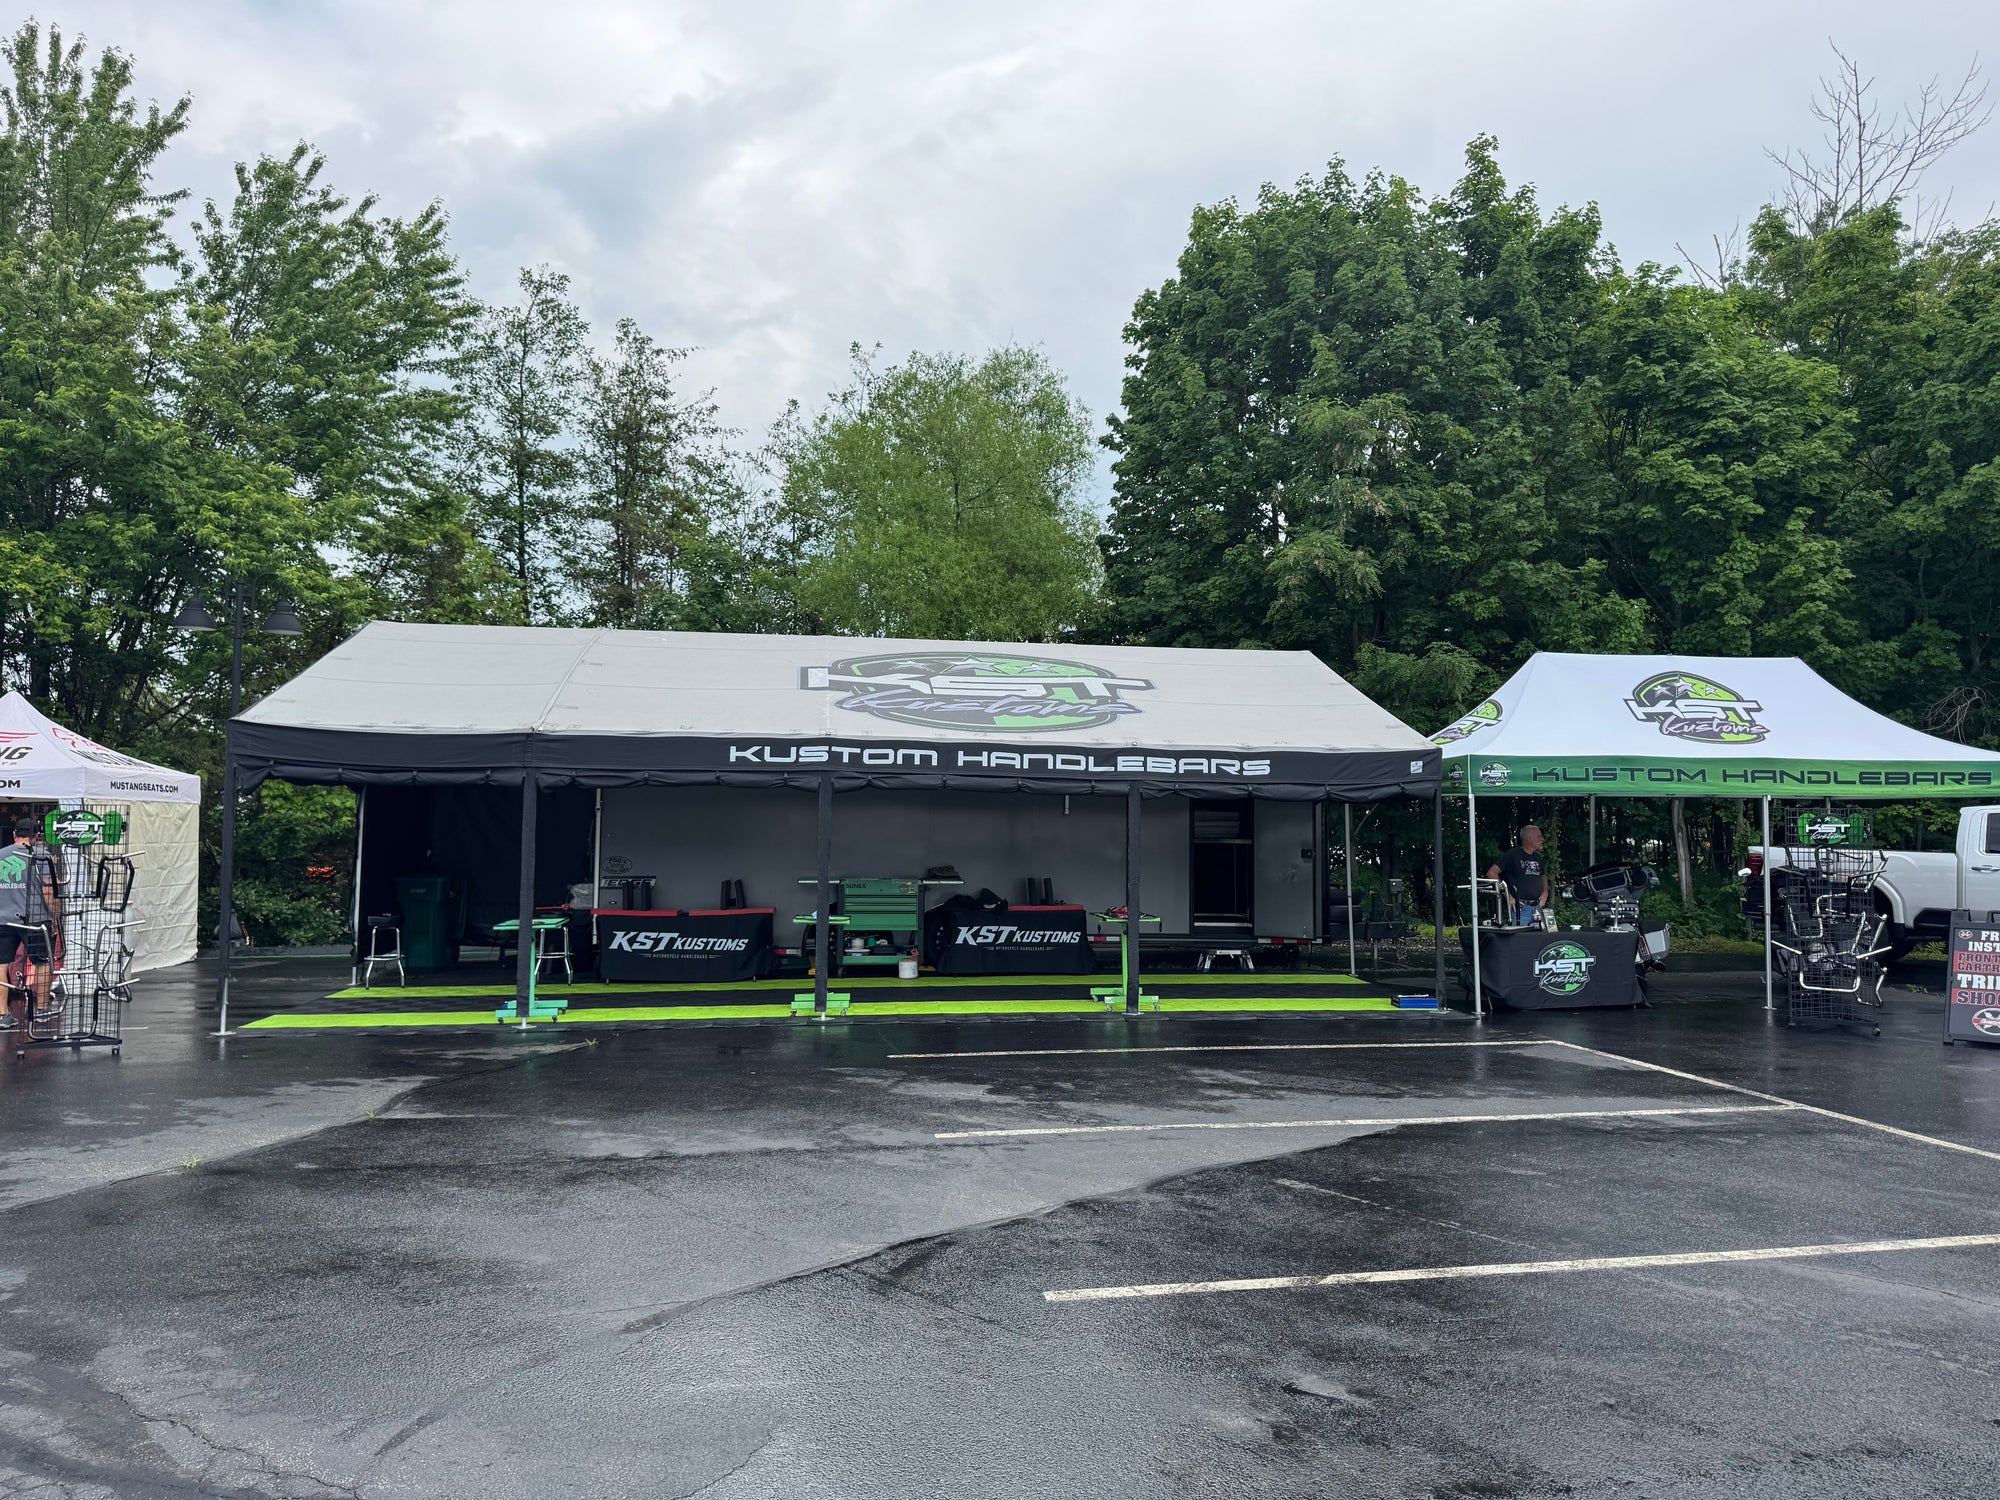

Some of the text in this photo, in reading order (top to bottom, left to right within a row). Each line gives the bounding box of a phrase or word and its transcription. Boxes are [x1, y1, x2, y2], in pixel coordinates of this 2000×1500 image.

[806, 666, 1148, 697] KST
[1625, 699, 1761, 720] KST
[1661, 714, 1768, 735] Kustoms
[729, 744, 1271, 776] KUSTOM HANDLEBARS
[1480, 769, 1511, 777] KST
[1532, 767, 1993, 787] KUSTOM HANDLEBARS
[110, 781, 179, 794] MUSTANGSEATS.COM
[52, 820, 106, 832] KST
[1805, 823, 1851, 833] KST
[608, 931, 749, 952] KST KUSTOMS
[955, 925, 1082, 946] KST KUSTOMS
[1534, 957, 1595, 975] KST
[1957, 990, 2000, 1006] SHO
